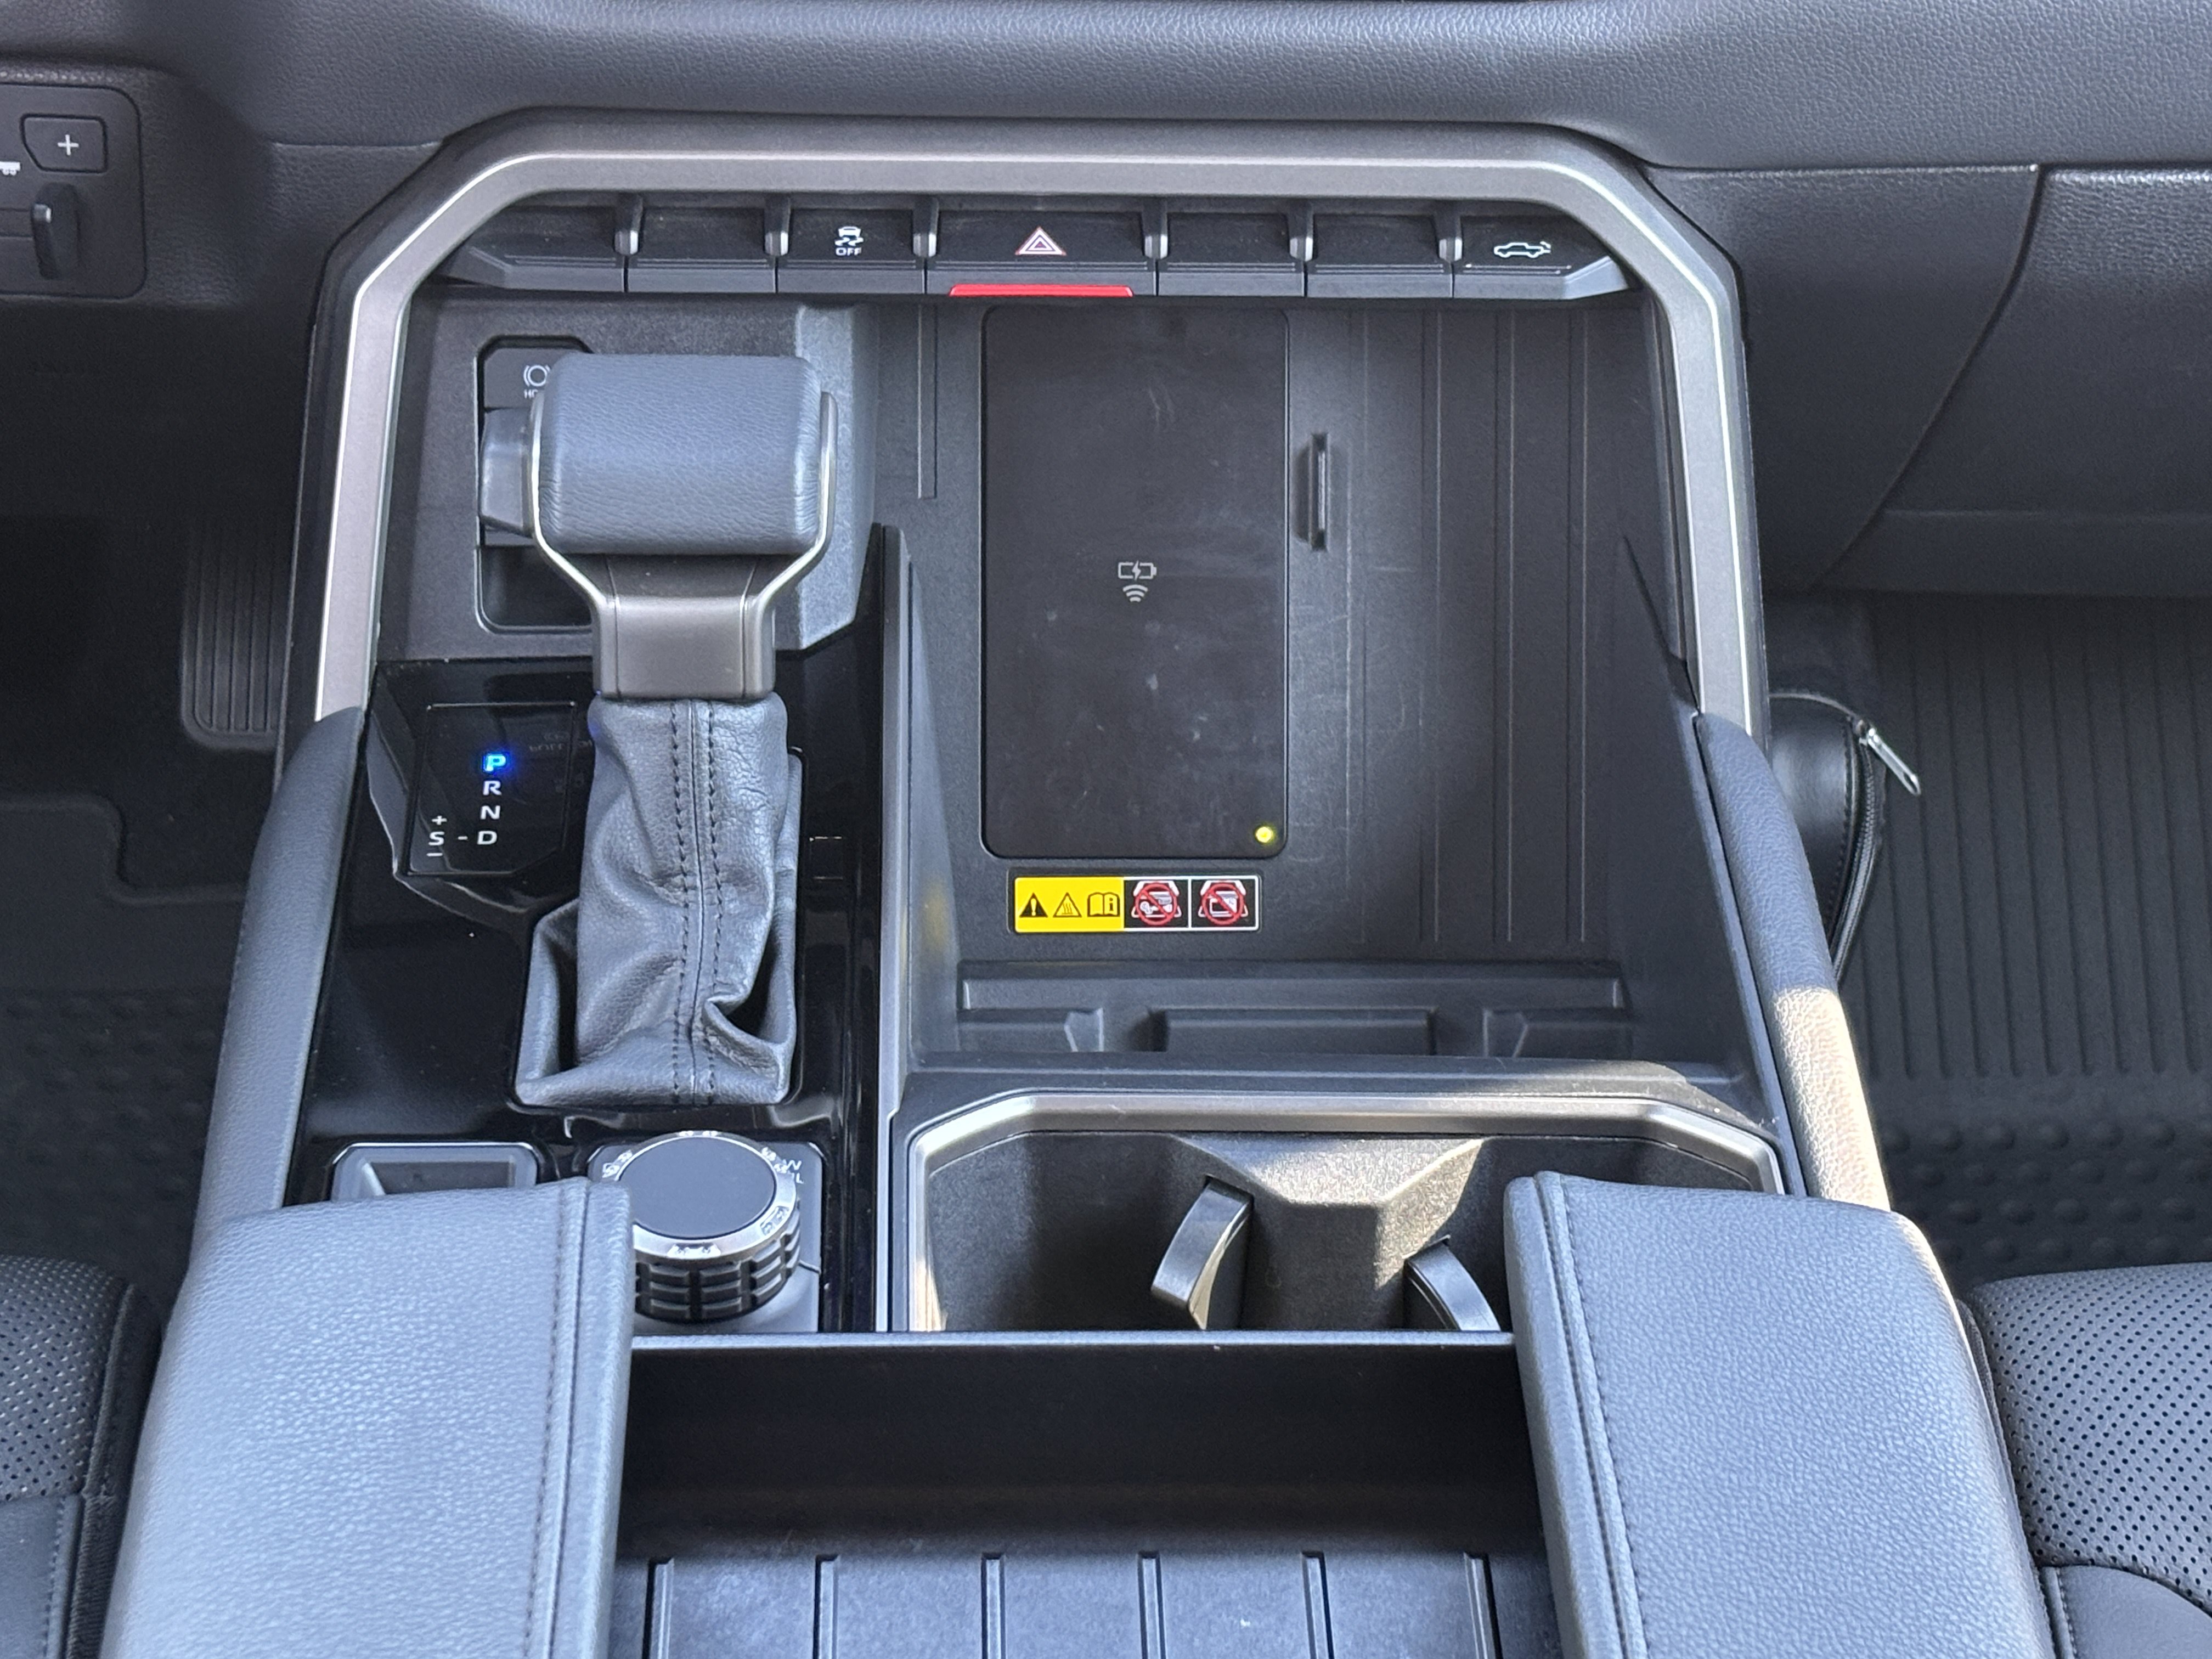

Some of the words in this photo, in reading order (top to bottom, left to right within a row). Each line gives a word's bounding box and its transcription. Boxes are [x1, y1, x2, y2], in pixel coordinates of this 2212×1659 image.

[835, 247, 862, 256] OFF
[484, 754, 507, 772] P
[483, 781, 503, 796] R
[480, 805, 501, 820] N
[428, 831, 445, 847] S
[477, 831, 498, 845] D
